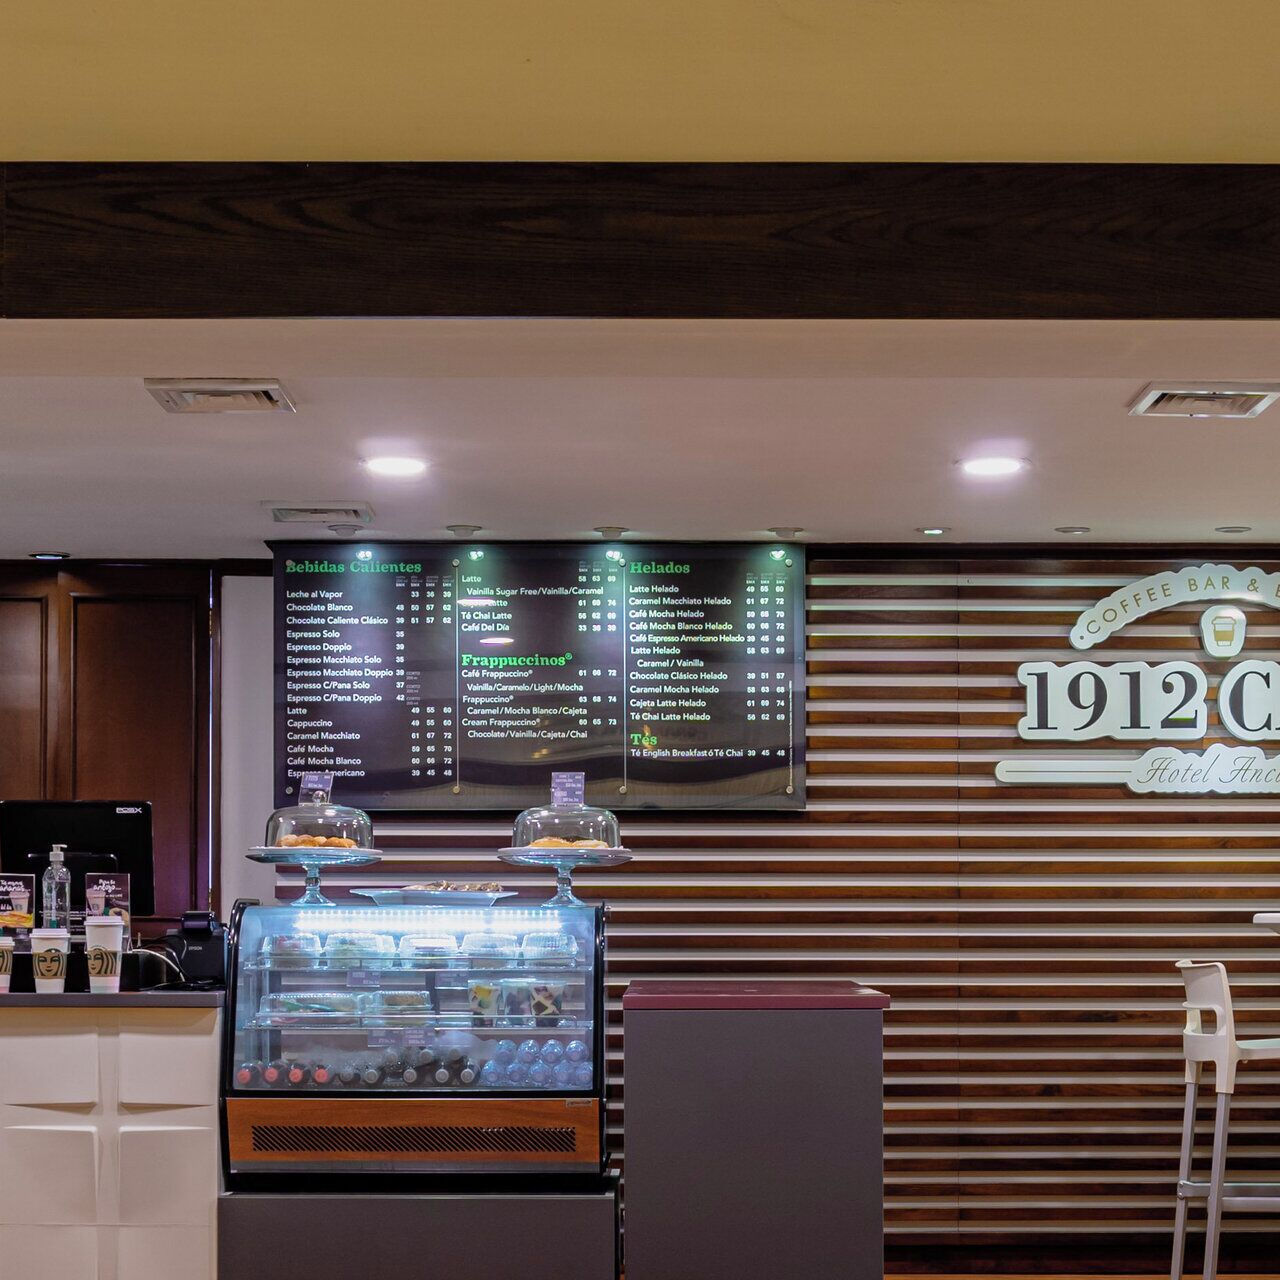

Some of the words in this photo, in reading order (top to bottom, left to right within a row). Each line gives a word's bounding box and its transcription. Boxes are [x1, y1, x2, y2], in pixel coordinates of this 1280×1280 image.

[286, 561, 345, 573] Bebidas
[350, 561, 421, 573] Calientes
[629, 562, 690, 574] Helados
[496, 588, 517, 597] Sugar
[630, 585, 649, 593] Latte
[651, 585, 679, 593] Helado
[320, 591, 343, 600] Vapor
[1086, 583, 1173, 635] COFFEE
[1188, 576, 1231, 592] BAR
[1246, 579, 1259, 593] &
[629, 610, 647, 618] Café
[649, 610, 675, 618] Mocha
[677, 610, 704, 618] Helado
[361, 616, 388, 624] Clásico
[630, 622, 648, 630] Café
[705, 622, 733, 630] Helado
[287, 631, 321, 639] Espresso
[648, 635, 679, 644] Espresso
[287, 644, 321, 652] Espresso
[323, 644, 352, 653] Doppio
[287, 656, 321, 665] Espresso
[677, 659, 704, 667] Vainilla
[287, 669, 321, 678] Espresso
[364, 669, 393, 678] Doppio
[630, 672, 669, 680] Chocolate
[671, 672, 698, 680] Clásico
[287, 682, 321, 691] Espresso
[287, 695, 321, 703] Espresso
[323, 694, 351, 702] C/Pana
[353, 695, 382, 703] Doppio
[1027, 671, 1198, 731] 1912
[287, 720, 332, 729] Cappuccino
[631, 733, 657, 745] Tés
[643, 749, 670, 758] English
[1137, 754, 1220, 783] Hotel
